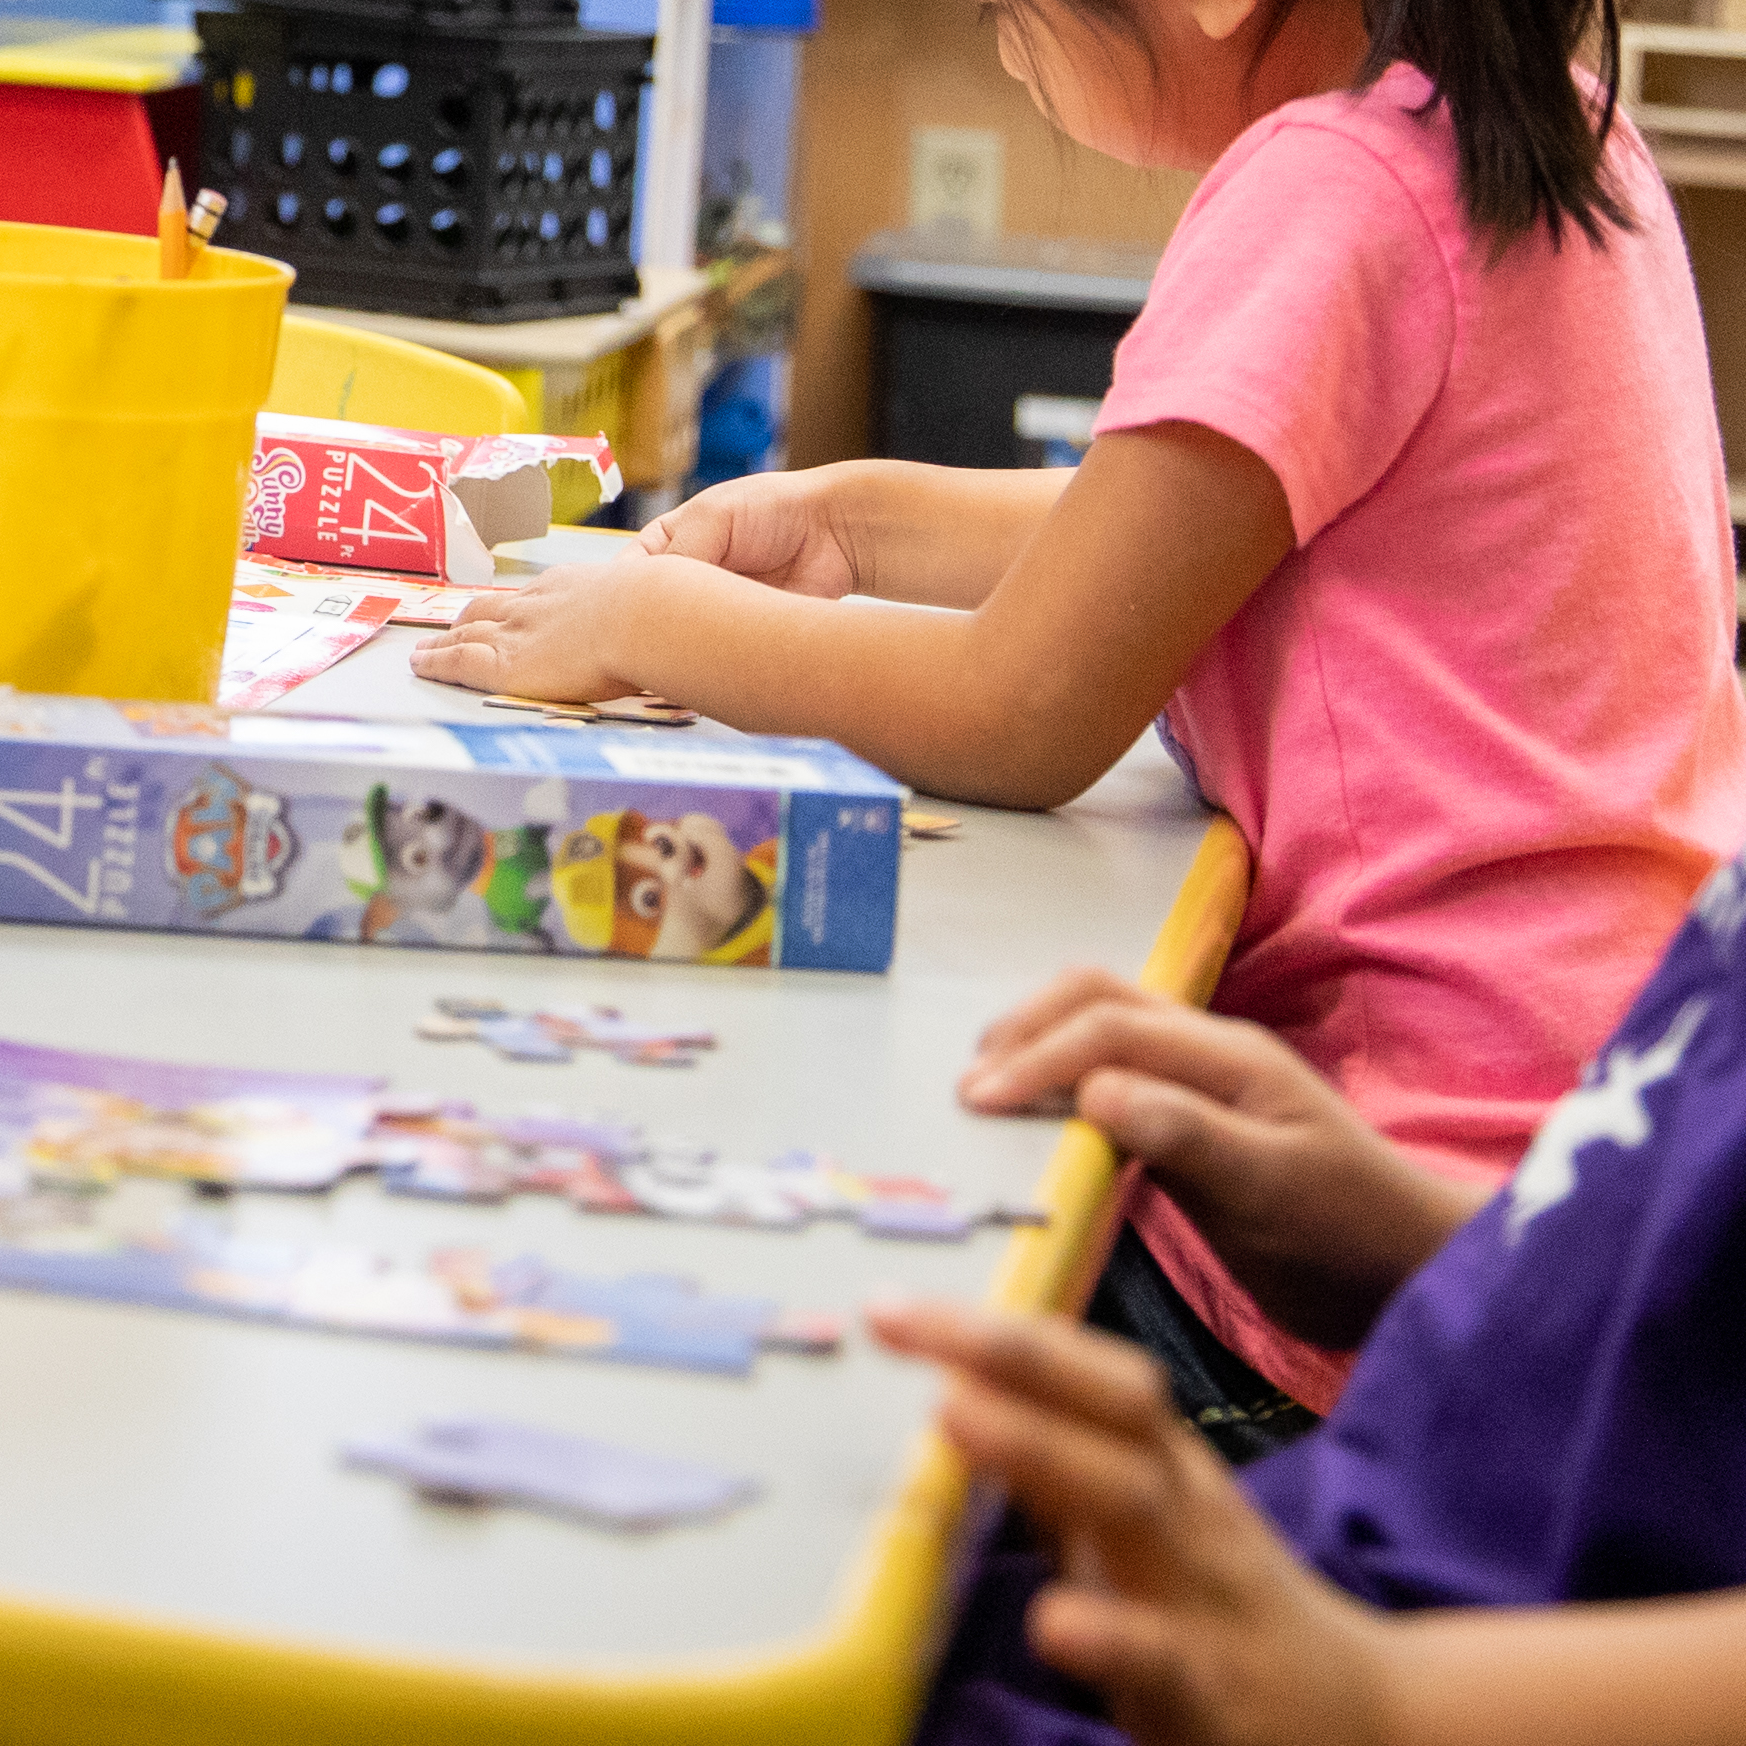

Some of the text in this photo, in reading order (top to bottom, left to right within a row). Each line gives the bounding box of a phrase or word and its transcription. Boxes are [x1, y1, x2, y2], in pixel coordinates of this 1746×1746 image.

[253, 450, 304, 535] Sunny
[317, 450, 346, 541] PUZZLE
[340, 452, 436, 545] 24
